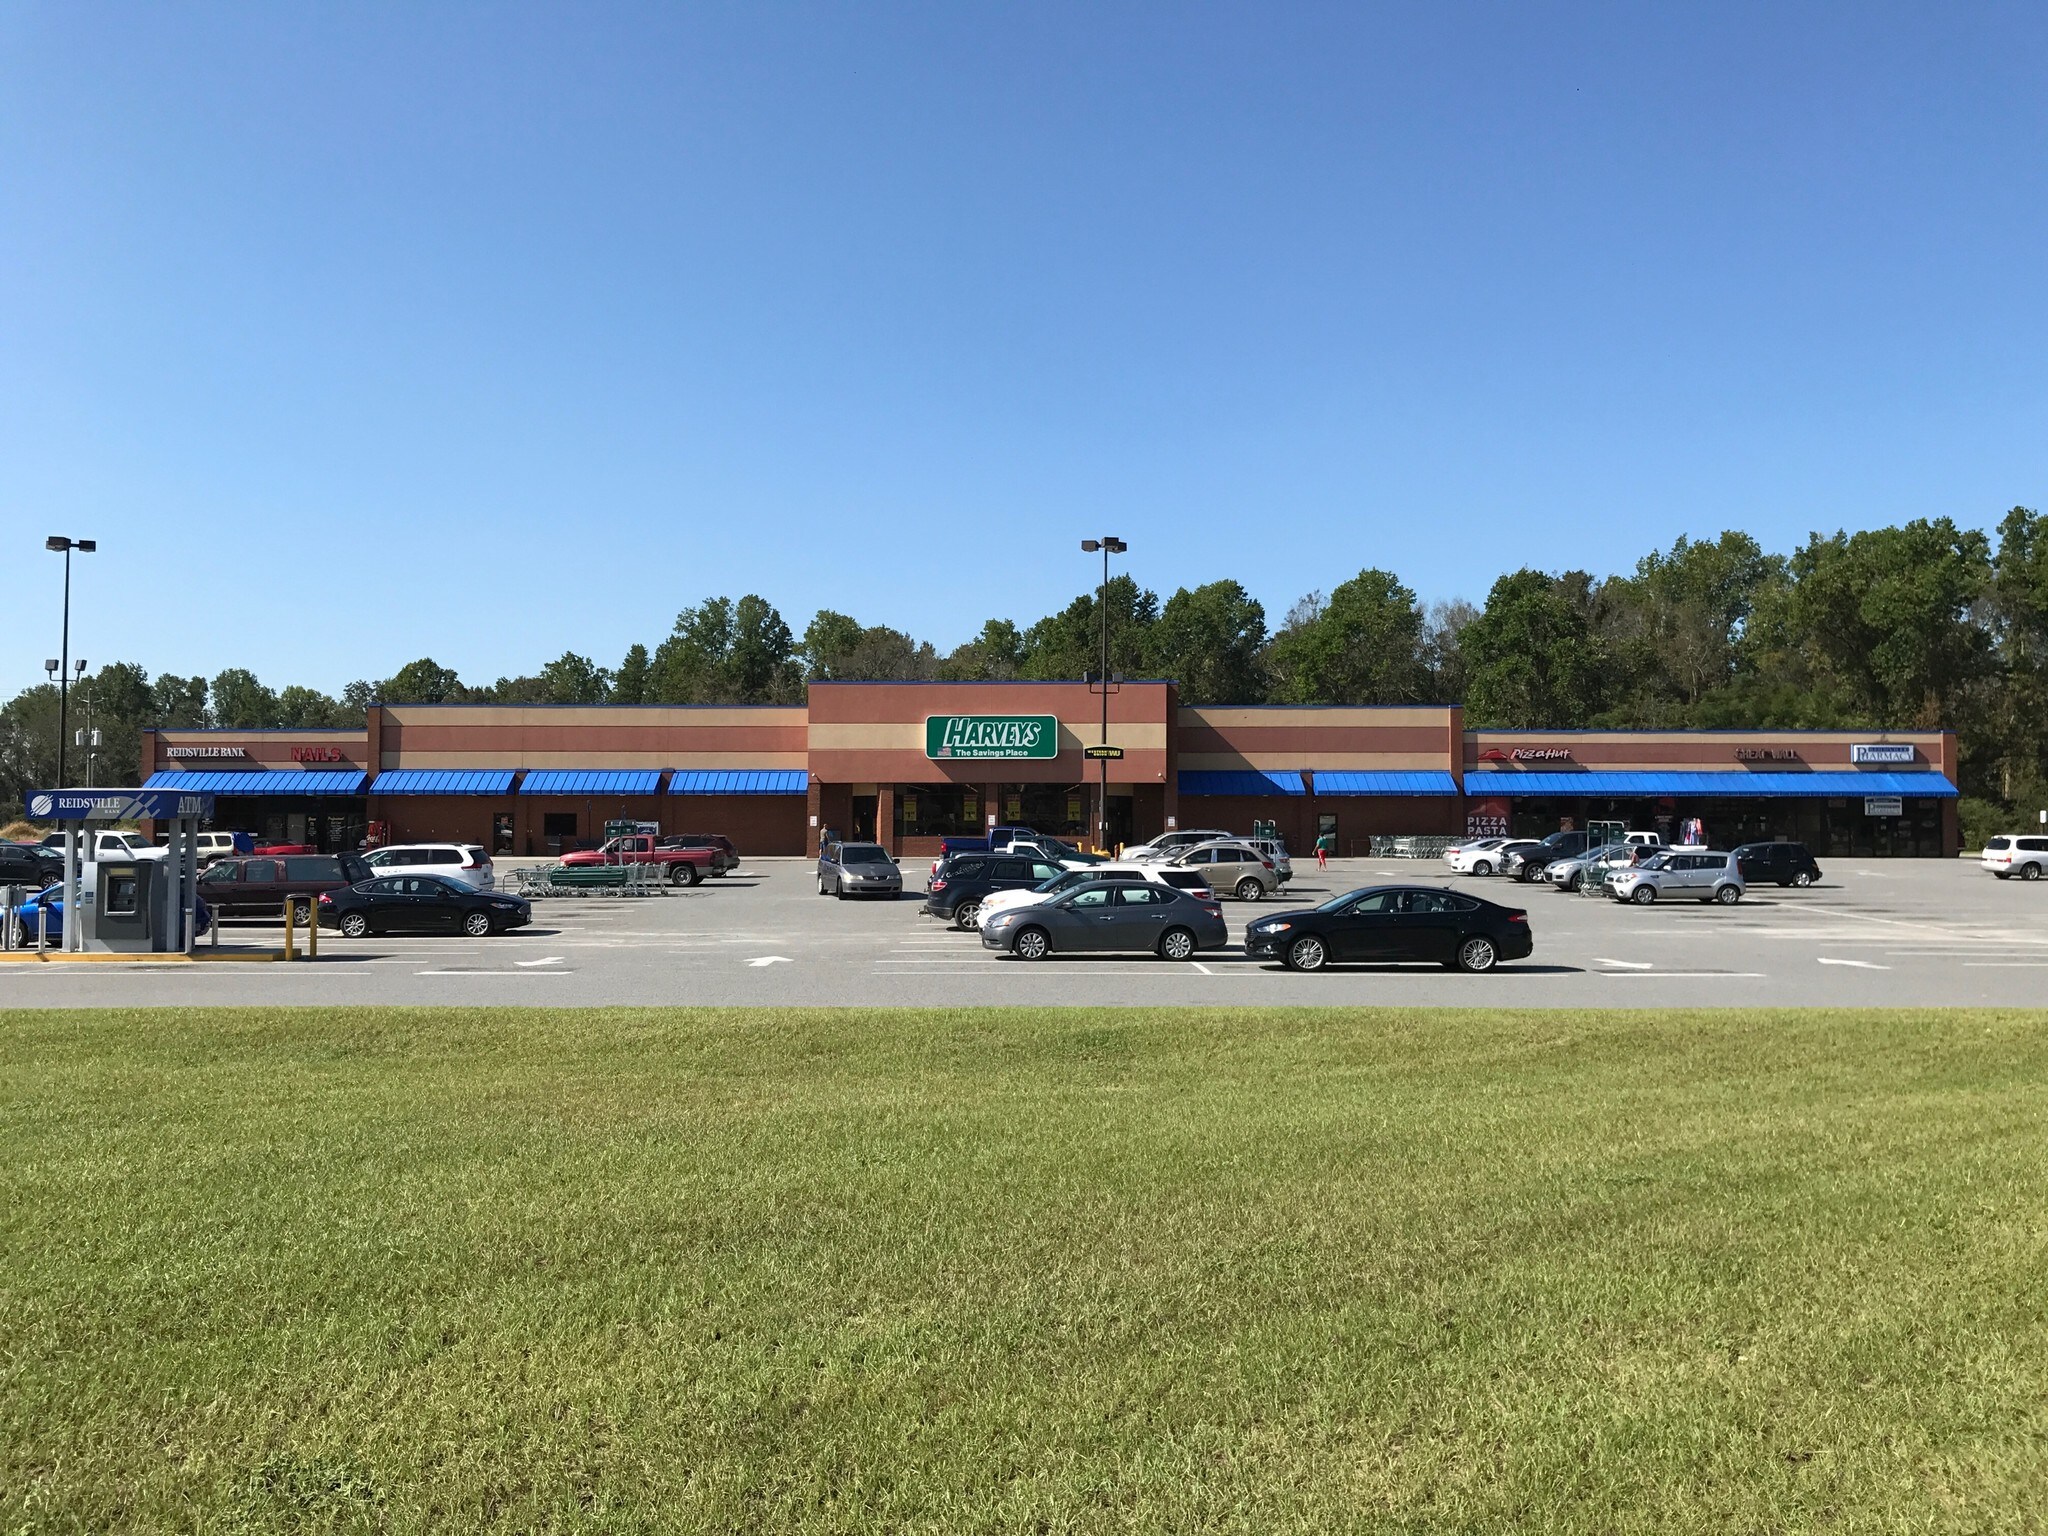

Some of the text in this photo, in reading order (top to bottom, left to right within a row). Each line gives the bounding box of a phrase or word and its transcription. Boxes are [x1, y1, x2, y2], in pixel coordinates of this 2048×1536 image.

[943, 718, 1041, 747] HARVEYS
[166, 747, 245, 757] REIDSVILLE BANK
[291, 747, 342, 761] NAILS
[972, 749, 1005, 758] Savings
[1735, 748, 1798, 759] GREAT WALL
[1856, 747, 1913, 761] PHARMACY
[58, 797, 120, 809] REIDSVILLE
[177, 796, 202, 813] ATM
[1467, 817, 1507, 825] PIZZA
[1467, 826, 1507, 835] PASTA
